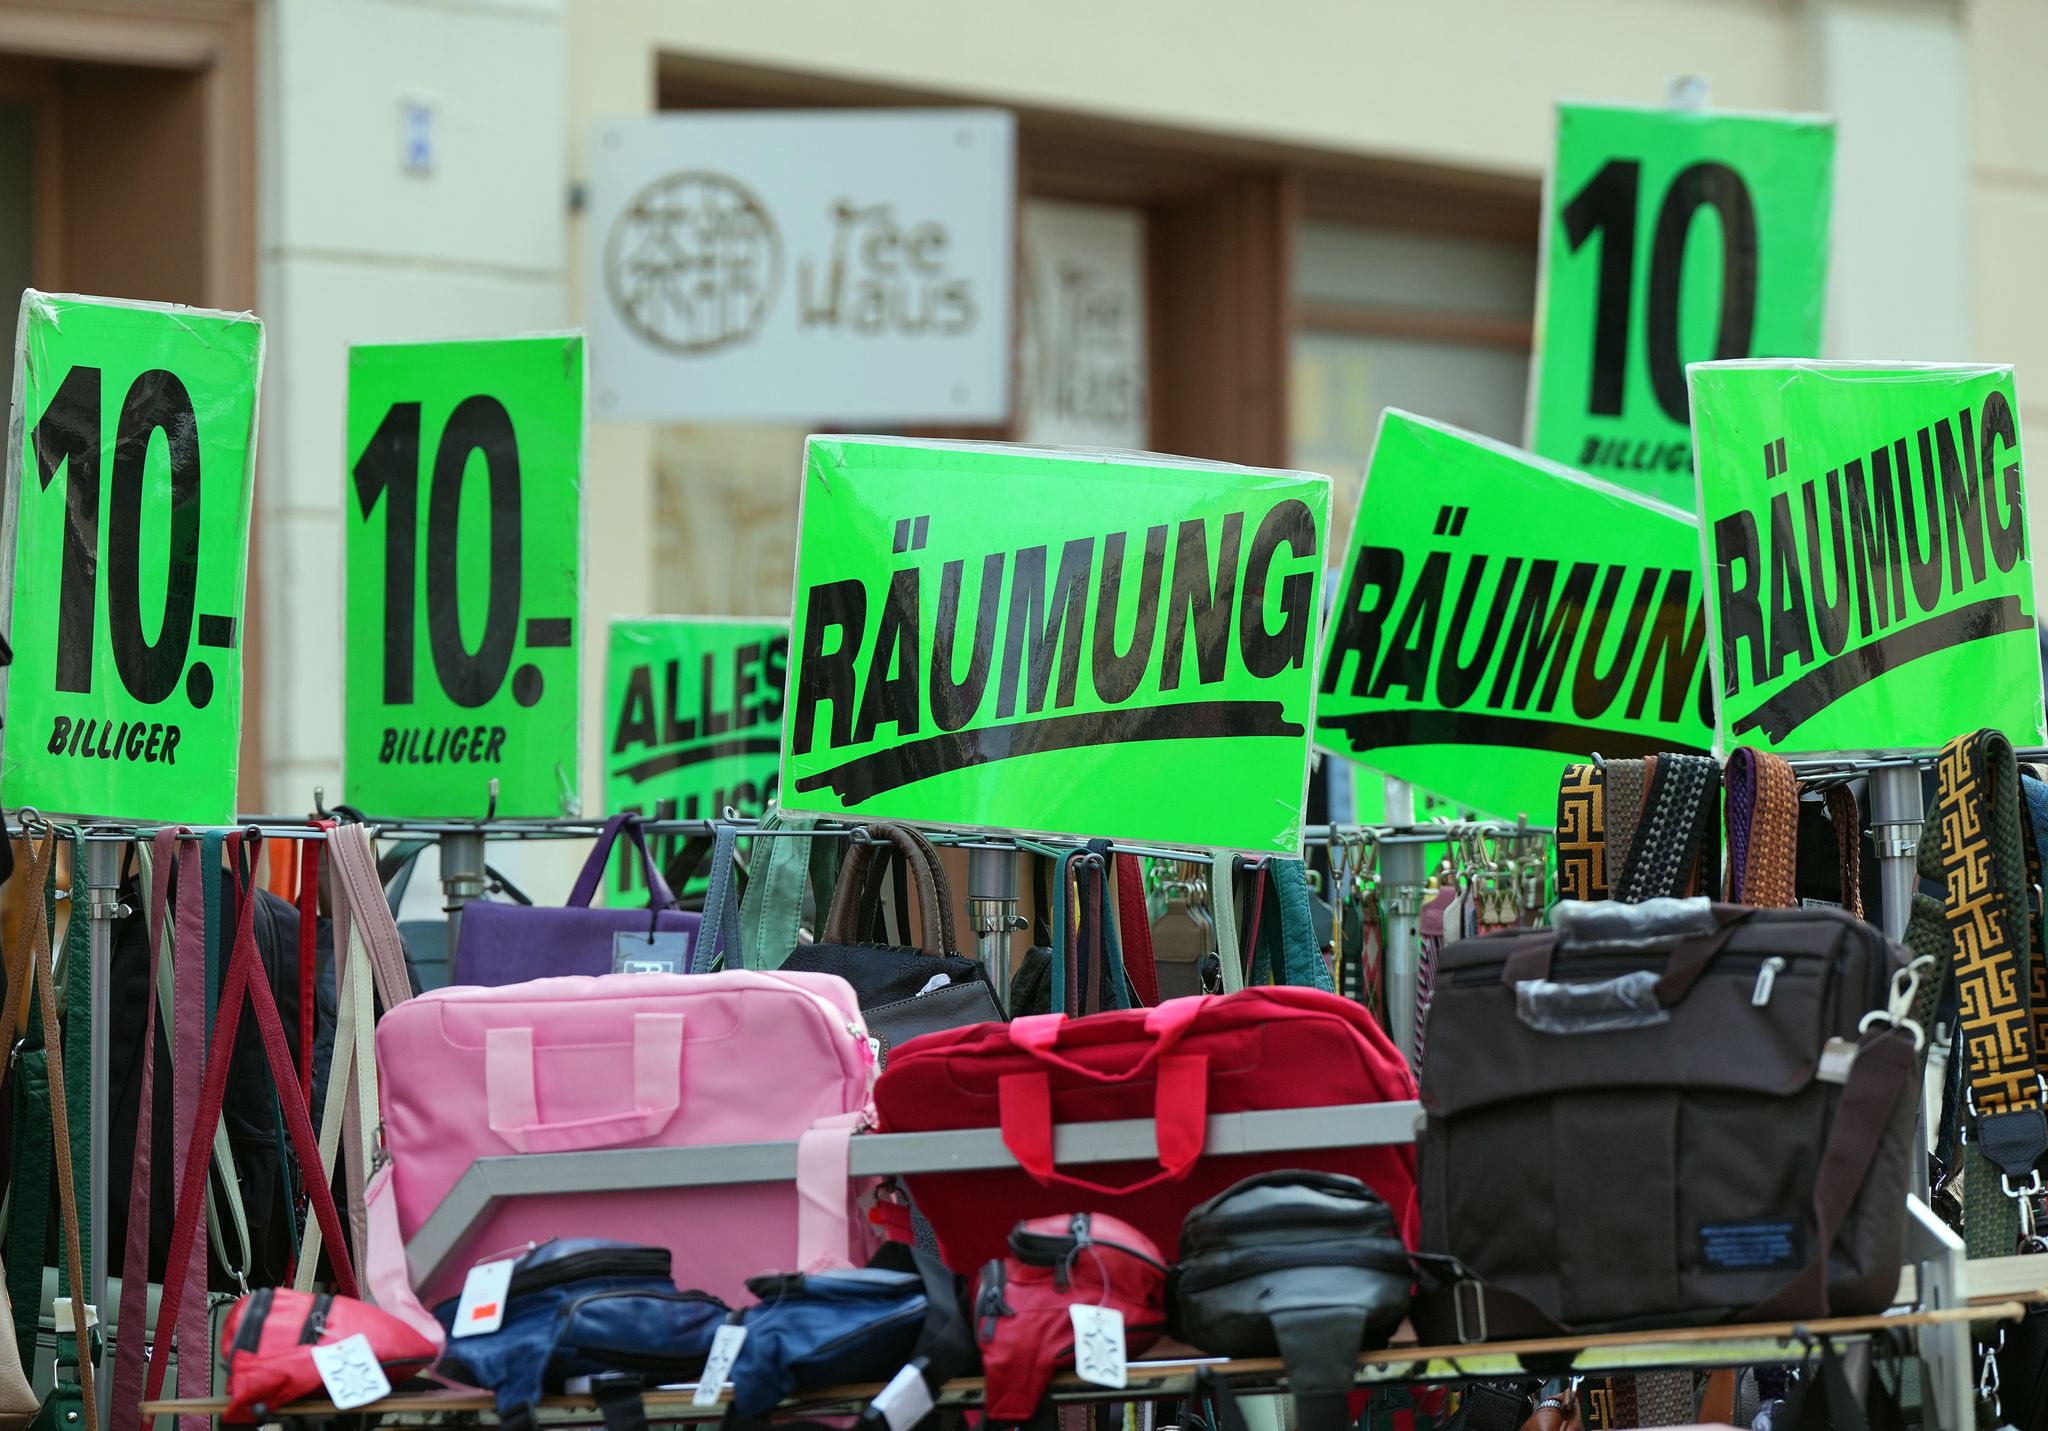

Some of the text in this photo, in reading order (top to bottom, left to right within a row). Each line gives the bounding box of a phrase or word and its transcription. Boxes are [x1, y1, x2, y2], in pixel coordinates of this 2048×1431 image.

[827, 196, 953, 277] Tee
[800, 257, 983, 337] Haus
[1713, 390, 2025, 700] RÄUMUNG
[791, 498, 1318, 757] RÄUMUNG
[1317, 504, 1716, 731] RÄUMUN
[46, 714, 181, 766] BILLIGER
[377, 724, 507, 766] BILLIGER
[611, 633, 786, 756] ALLES
